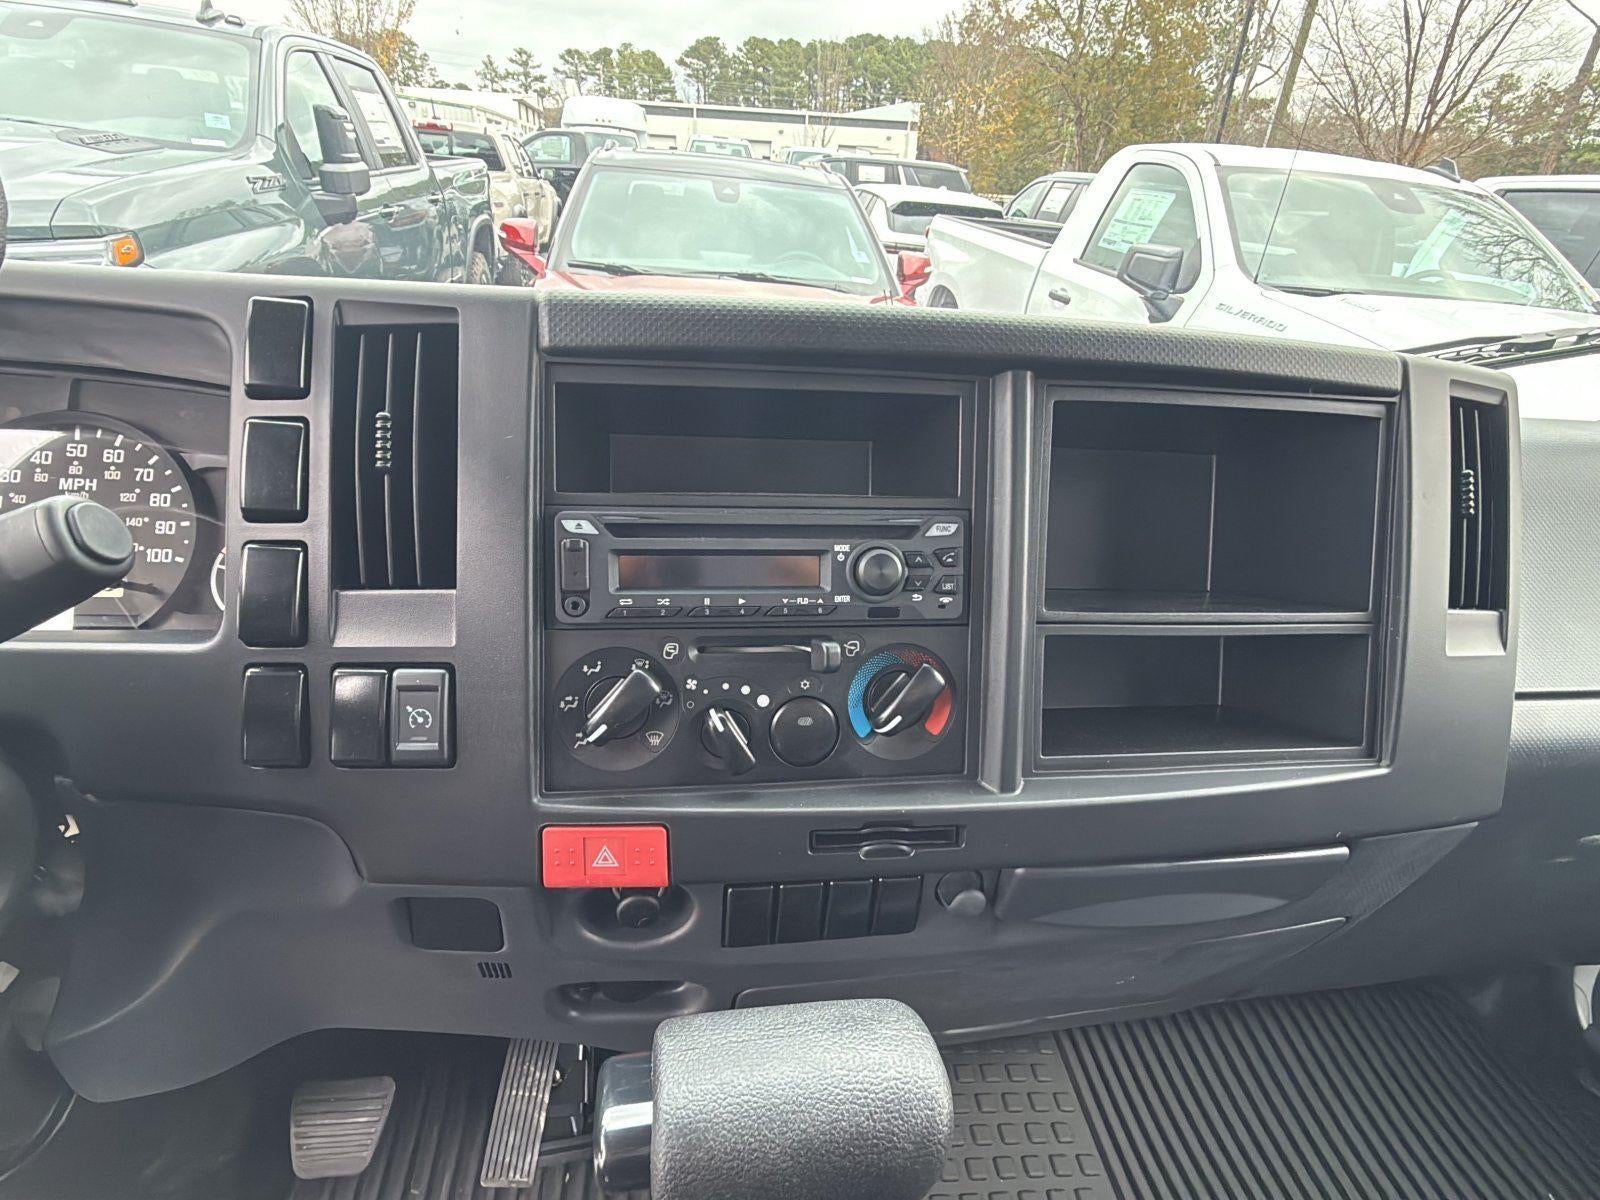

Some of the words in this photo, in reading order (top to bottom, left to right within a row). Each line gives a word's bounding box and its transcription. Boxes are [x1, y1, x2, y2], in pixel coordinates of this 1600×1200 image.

[1216, 303, 1288, 332] SILVERADO
[66, 443, 88, 458] 50
[30, 450, 53, 465] 40
[102, 449, 125, 463] 60
[68, 465, 83, 475] 80
[104, 470, 121, 480] 100
[134, 468, 154, 482] 70
[34, 473, 49, 483] 60
[59, 477, 98, 491] MPH
[11, 494, 26, 504] 40
[119, 492, 137, 502] 120
[149, 493, 171, 507] 80
[125, 517, 143, 527] 140
[155, 520, 176, 535] 90
[935, 525, 952, 533] FUNC
[834, 544, 850, 552] MODE
[146, 548, 173, 563] 100
[941, 582, 955, 591] LIST
[796, 597, 809, 605] FLD
[834, 595, 851, 603] ENTER
